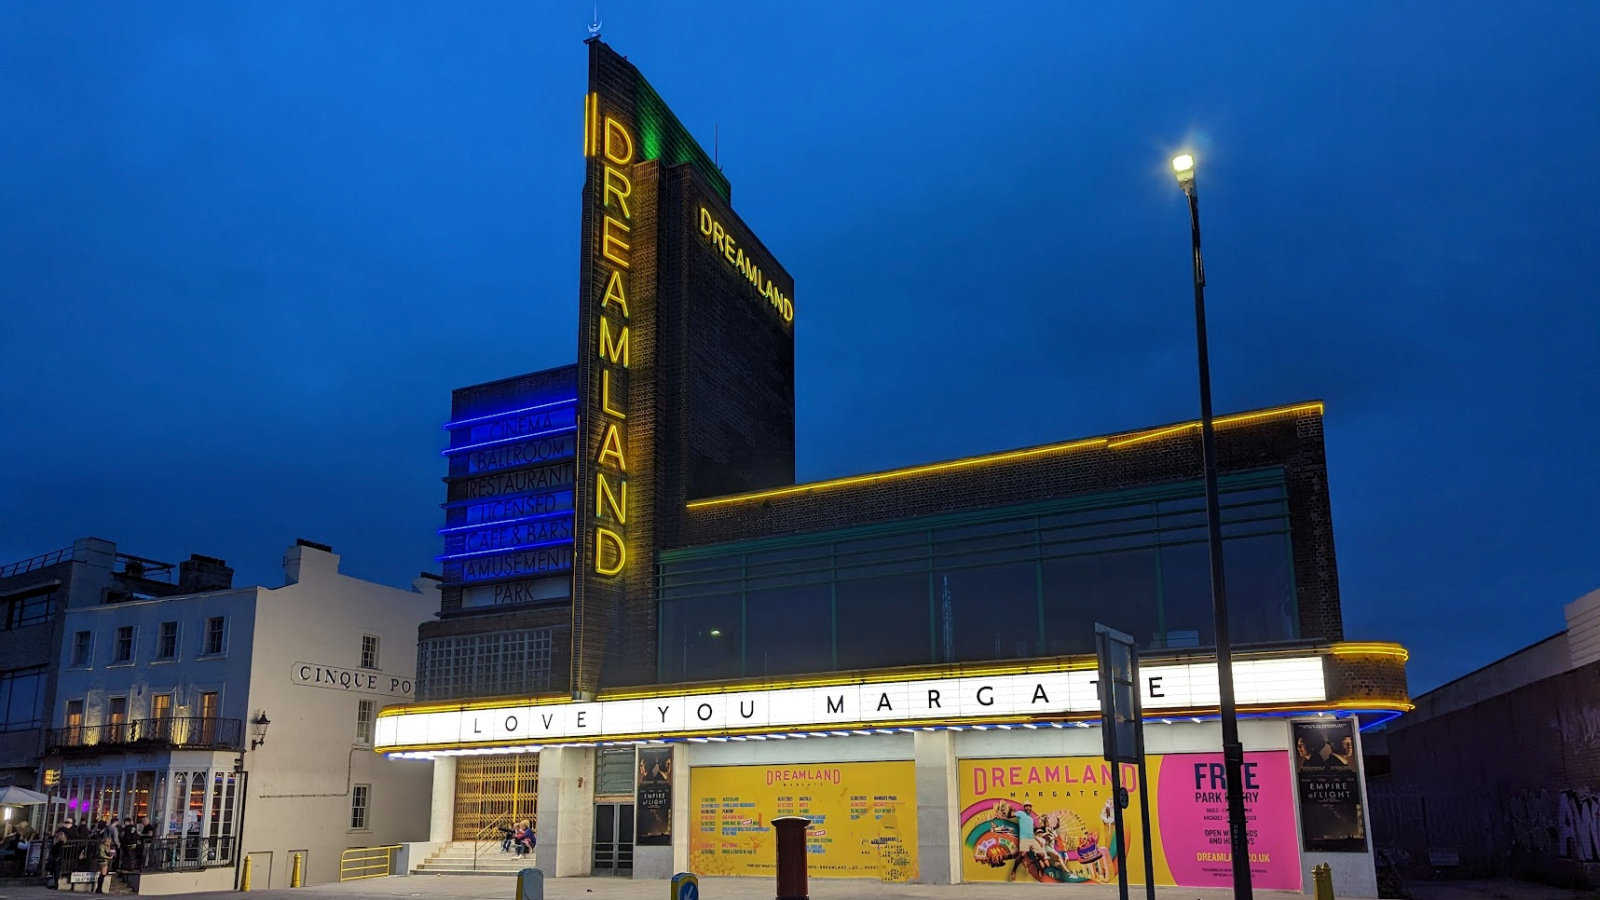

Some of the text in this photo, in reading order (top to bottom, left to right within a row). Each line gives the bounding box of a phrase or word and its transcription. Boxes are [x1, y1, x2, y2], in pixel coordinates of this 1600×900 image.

[699, 206, 795, 323] DREAMLAND
[595, 115, 634, 577] DREAMLAND
[490, 412, 553, 437] CINEMA
[477, 438, 565, 469] BALLROOM
[468, 463, 570, 498] RESTAURANT
[482, 494, 556, 522] LICENSED
[512, 524, 522, 545] &
[527, 517, 570, 543] BARS
[467, 549, 571, 578] AMUSEMENT
[494, 582, 535, 605] PARK
[300, 665, 412, 693] CINQUE PO
[473, 711, 587, 734] LOVE
[657, 699, 754, 724] YOU
[767, 768, 841, 786] DREAMLAND
[973, 763, 1138, 796] DREAMLAND
[1194, 762, 1260, 790] FRE
[1195, 792, 1222, 803] PARK
